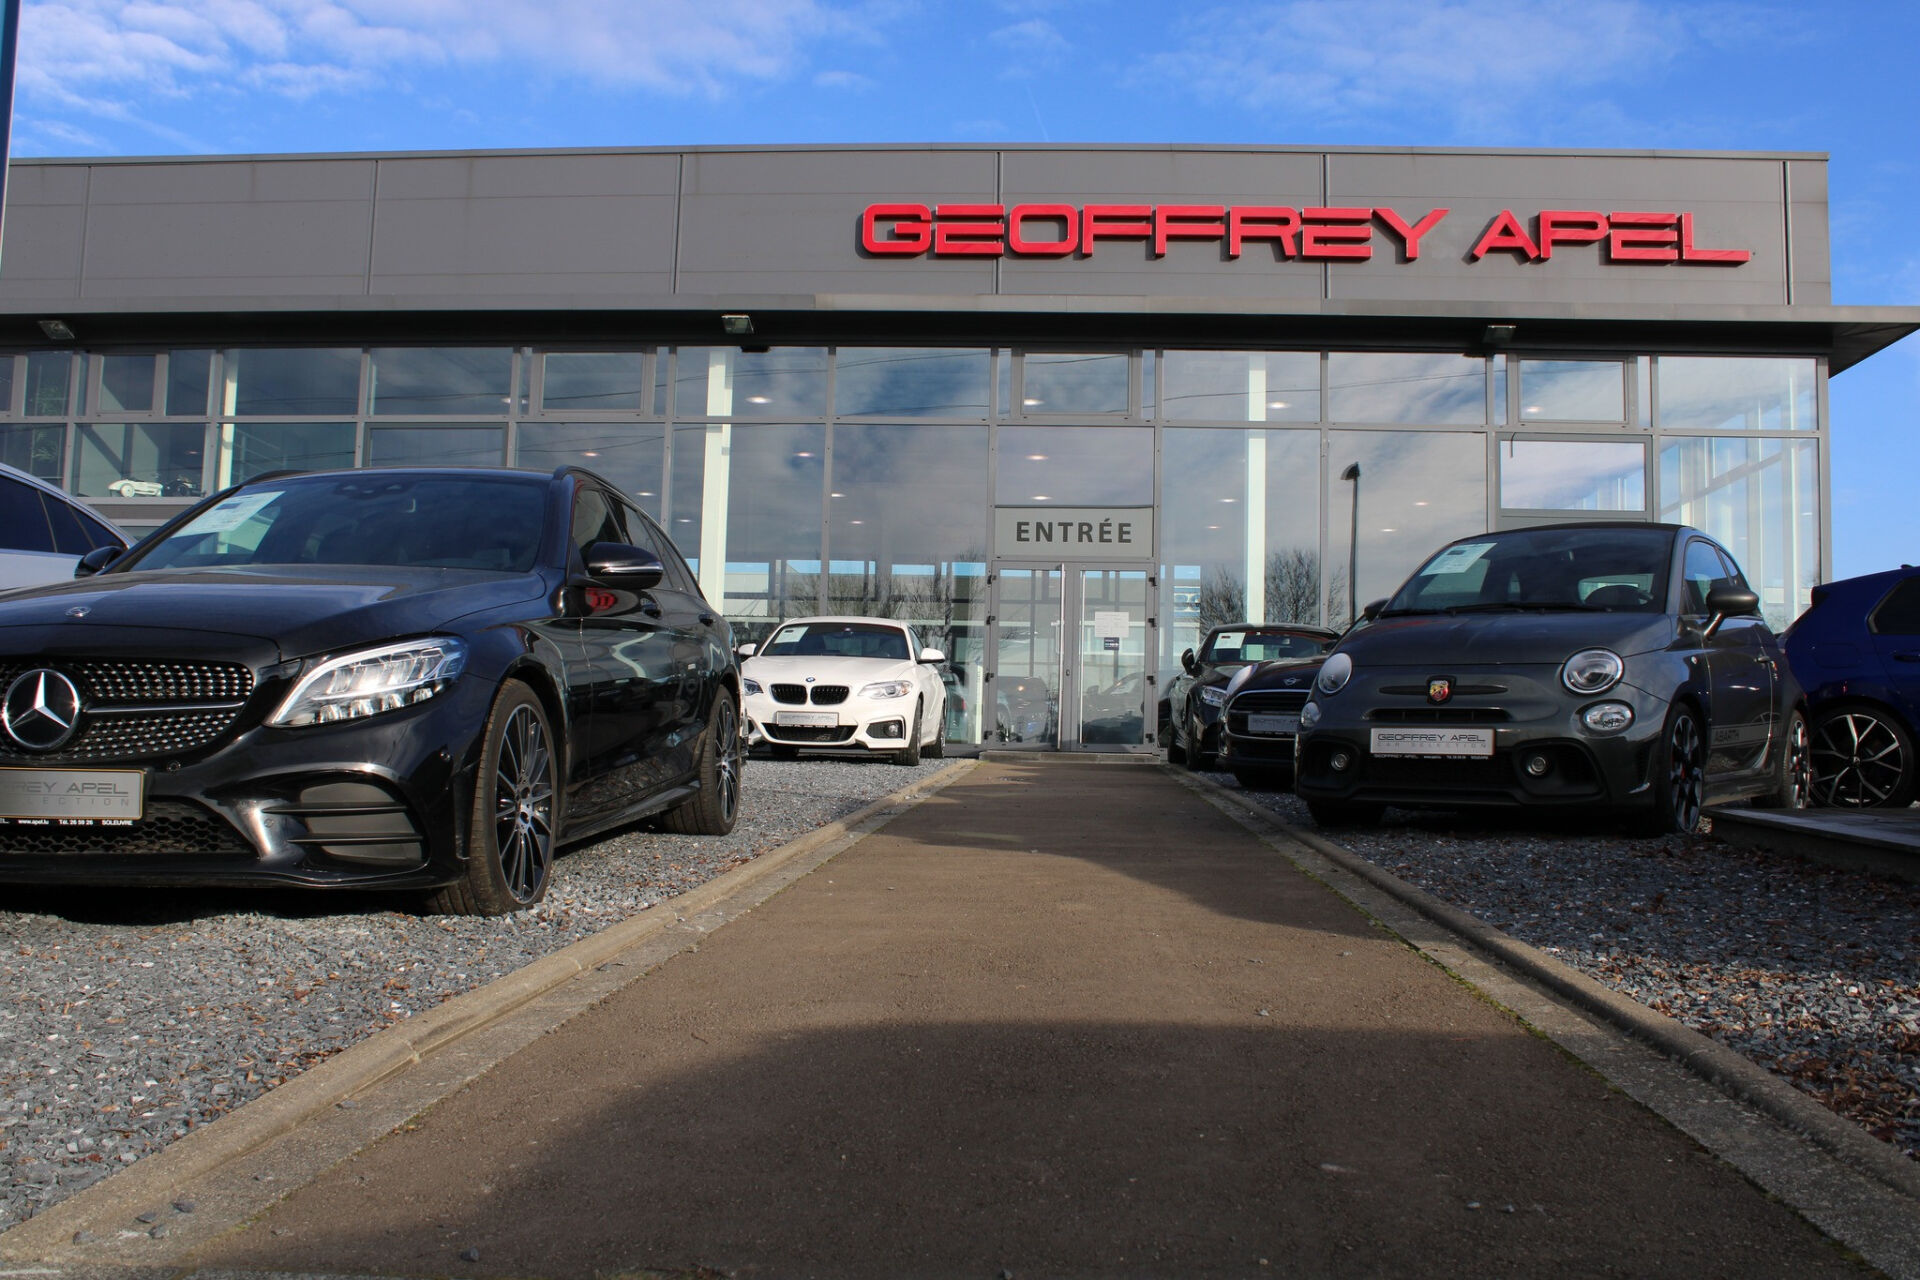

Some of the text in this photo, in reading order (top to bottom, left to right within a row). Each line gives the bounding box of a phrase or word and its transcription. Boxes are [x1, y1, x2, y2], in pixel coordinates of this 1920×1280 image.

[861, 204, 1751, 262] GEOFFREY APEL
[1016, 518, 1132, 543] ENTRÉE
[1377, 733, 1486, 742] GEOFFREY APEL
[67, 782, 129, 794] APEL
